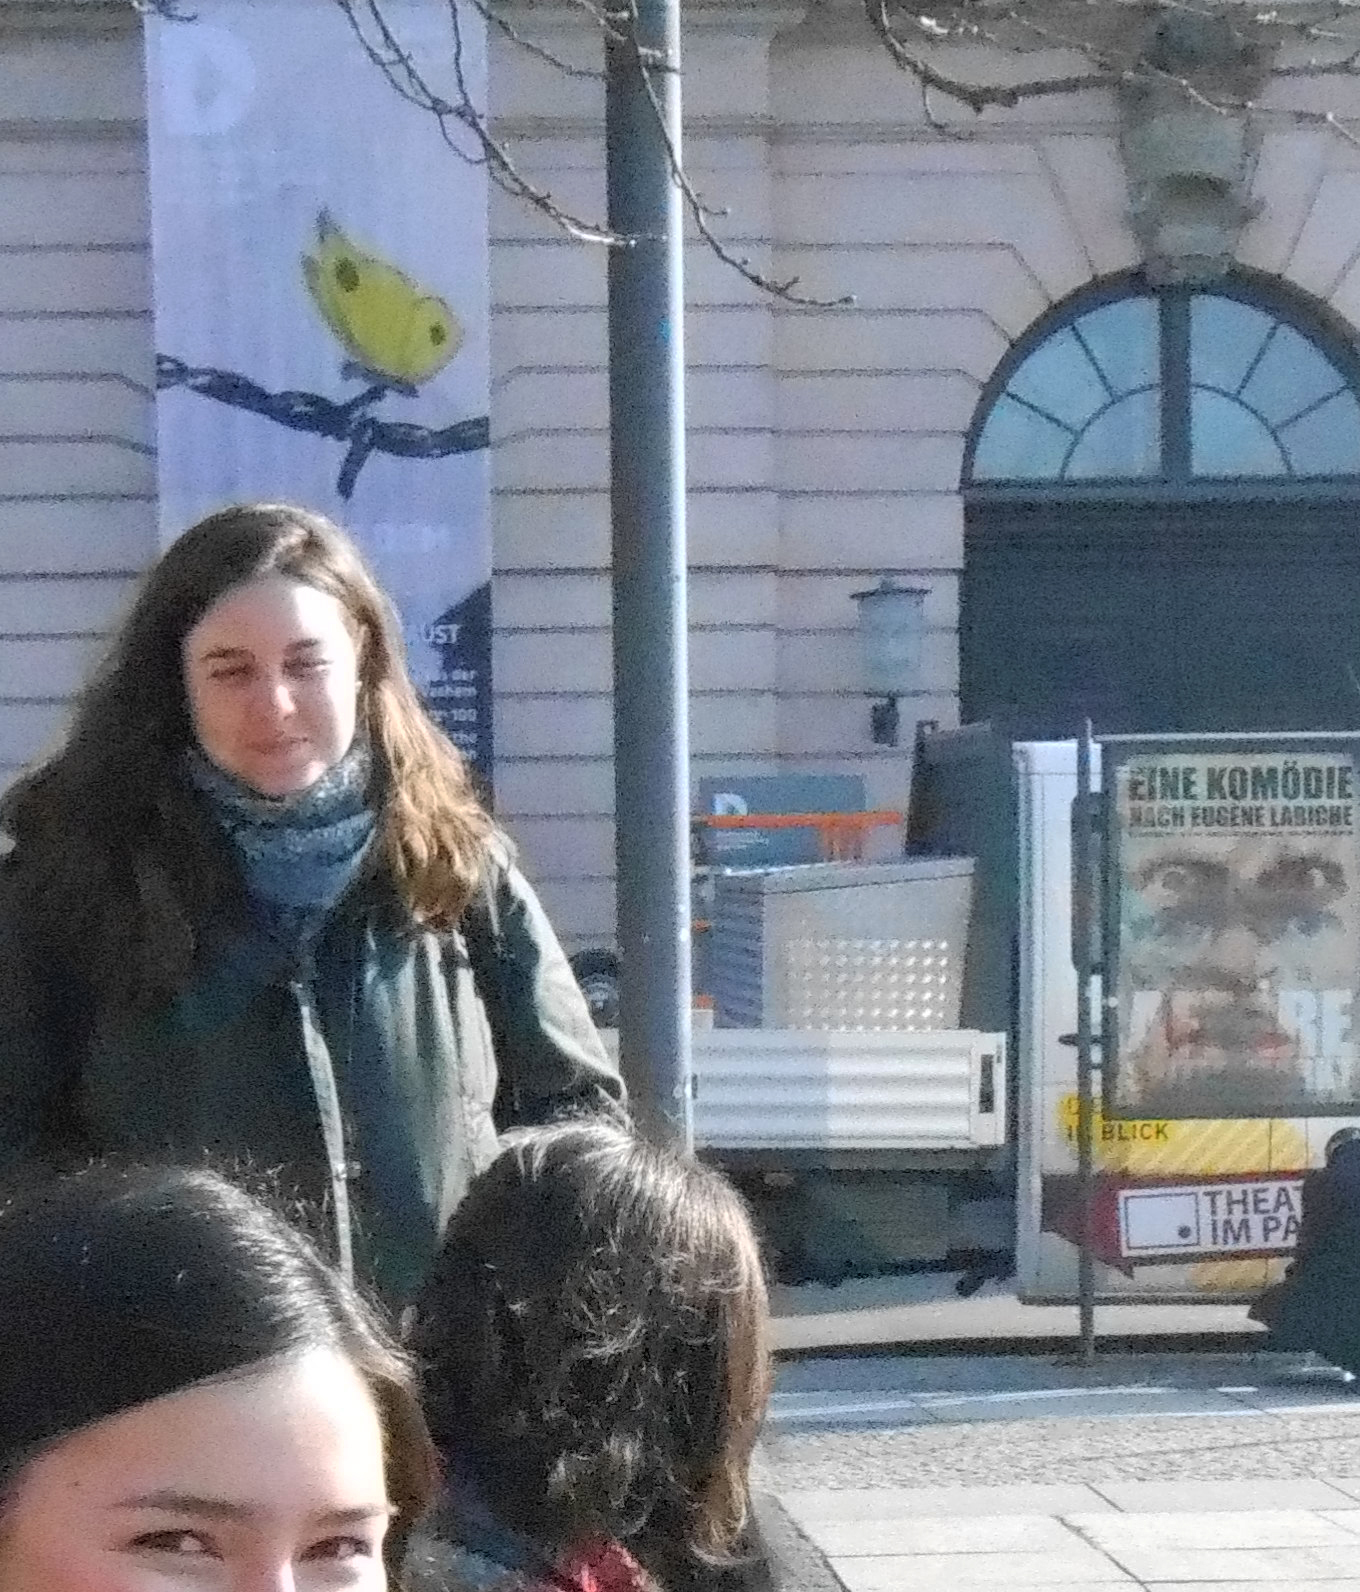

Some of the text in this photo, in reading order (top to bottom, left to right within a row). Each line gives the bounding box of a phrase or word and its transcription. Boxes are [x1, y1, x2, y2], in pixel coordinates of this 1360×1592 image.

[1128, 759, 1354, 801] EINE KOMÖDIE
[1129, 805, 1186, 828] NACH
[1101, 1122, 1170, 1142] BLICK
[1211, 1213, 1302, 1246] IM PA
